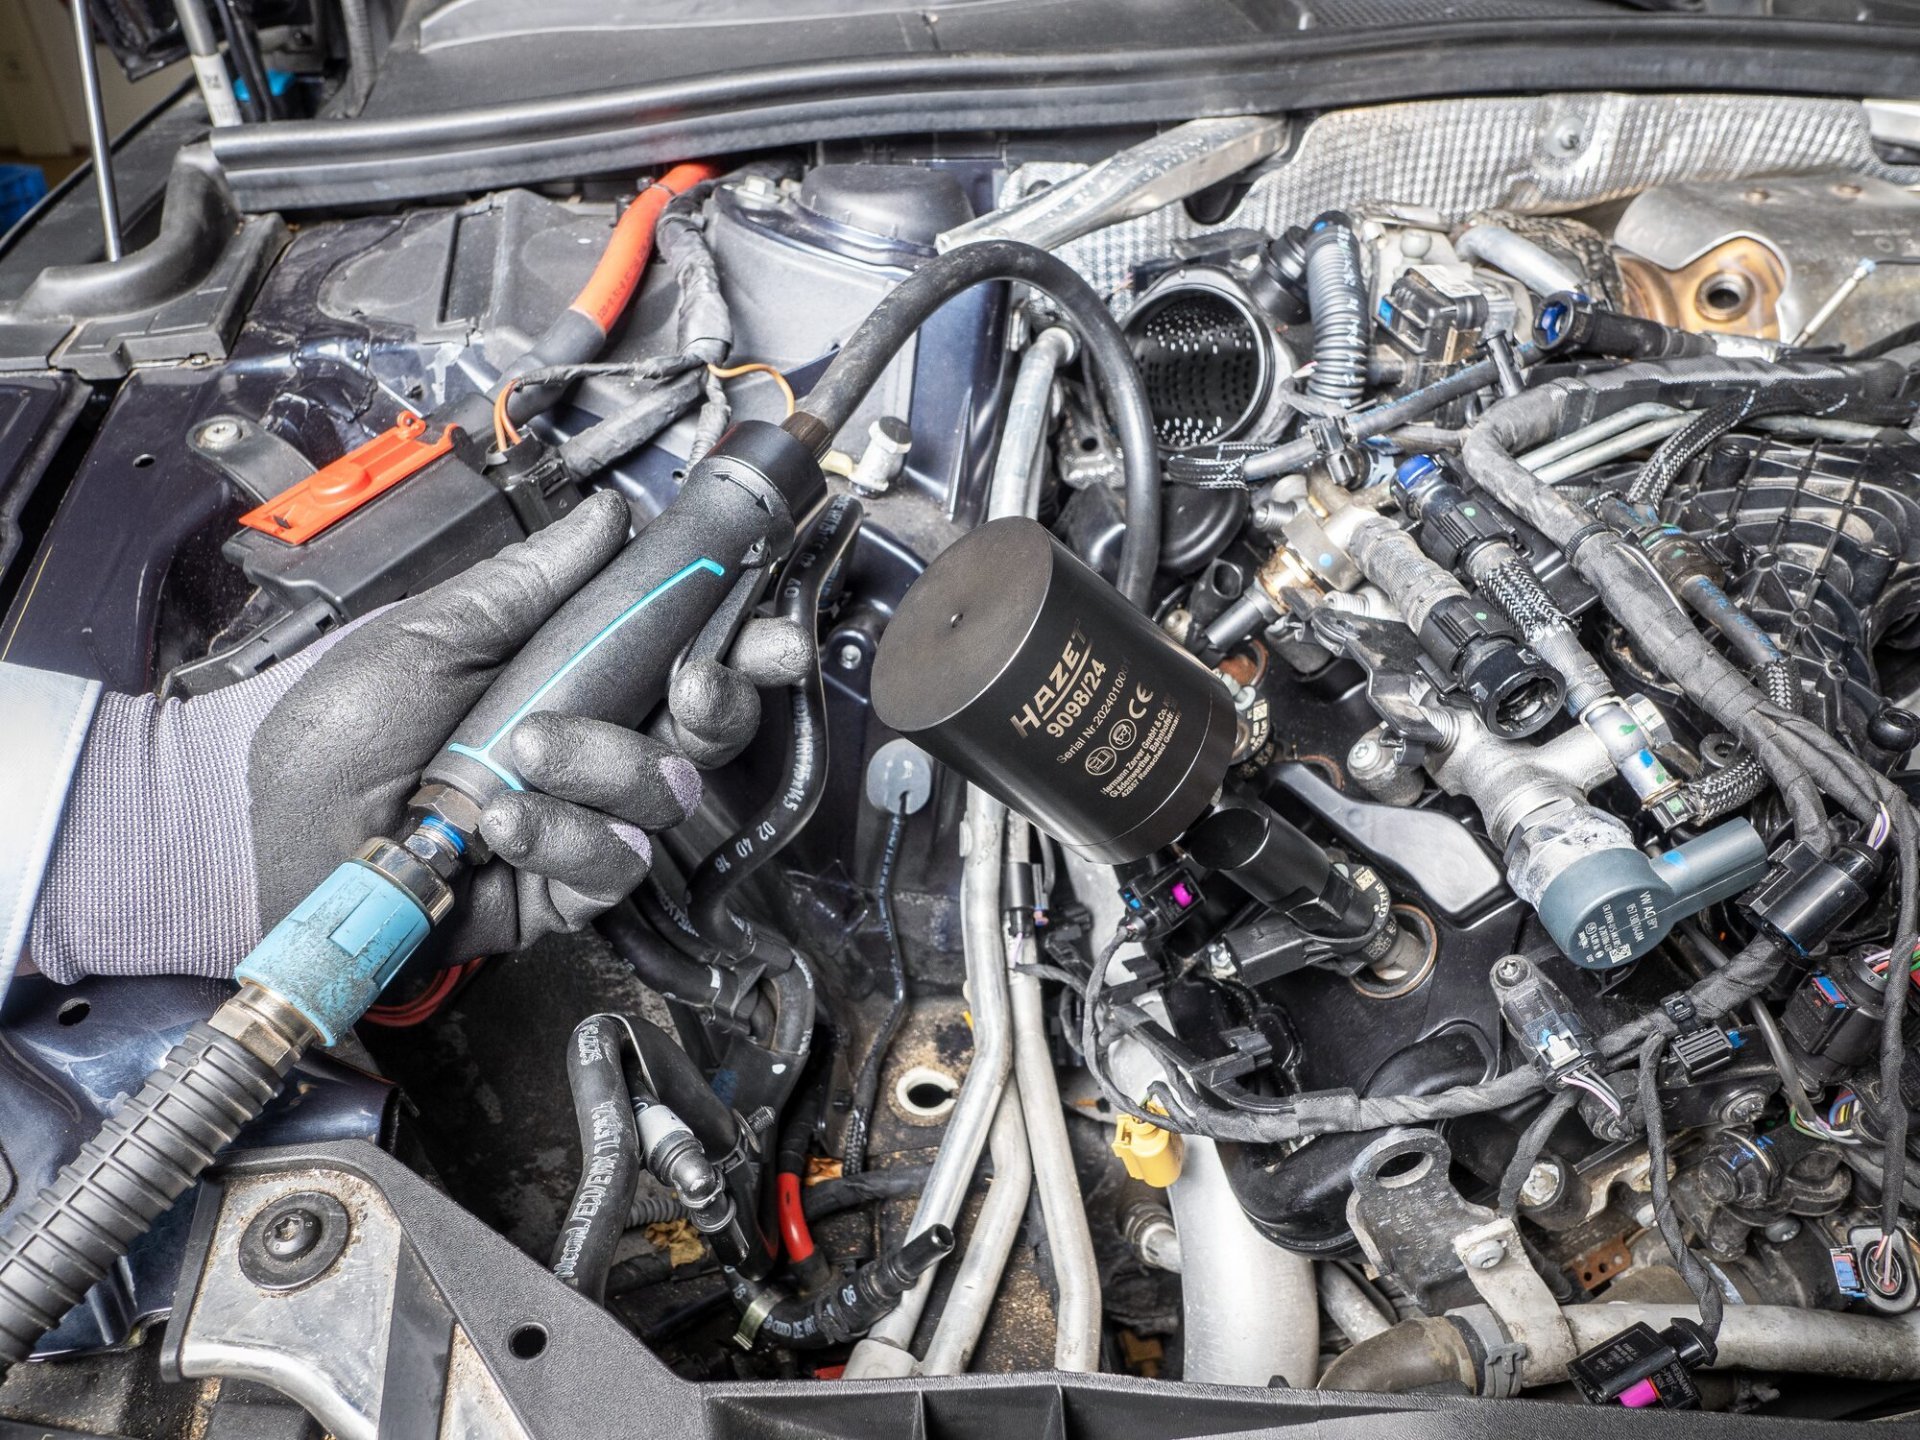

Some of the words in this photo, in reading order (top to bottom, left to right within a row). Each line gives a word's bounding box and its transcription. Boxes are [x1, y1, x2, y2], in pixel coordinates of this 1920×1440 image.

[1009, 618, 1086, 739] HAZET
[1047, 658, 1109, 739] 9098/24
[1058, 736, 1086, 764] Serial
[1100, 769, 1129, 795] Hermann
[1125, 749, 1145, 770] Zerver
[1141, 726, 1159, 749] GmbH
[1137, 742, 1166, 781] Remscheid
[756, 821, 775, 840] 02
[736, 838, 753, 858] 40
[1640, 891, 1652, 904] VW
